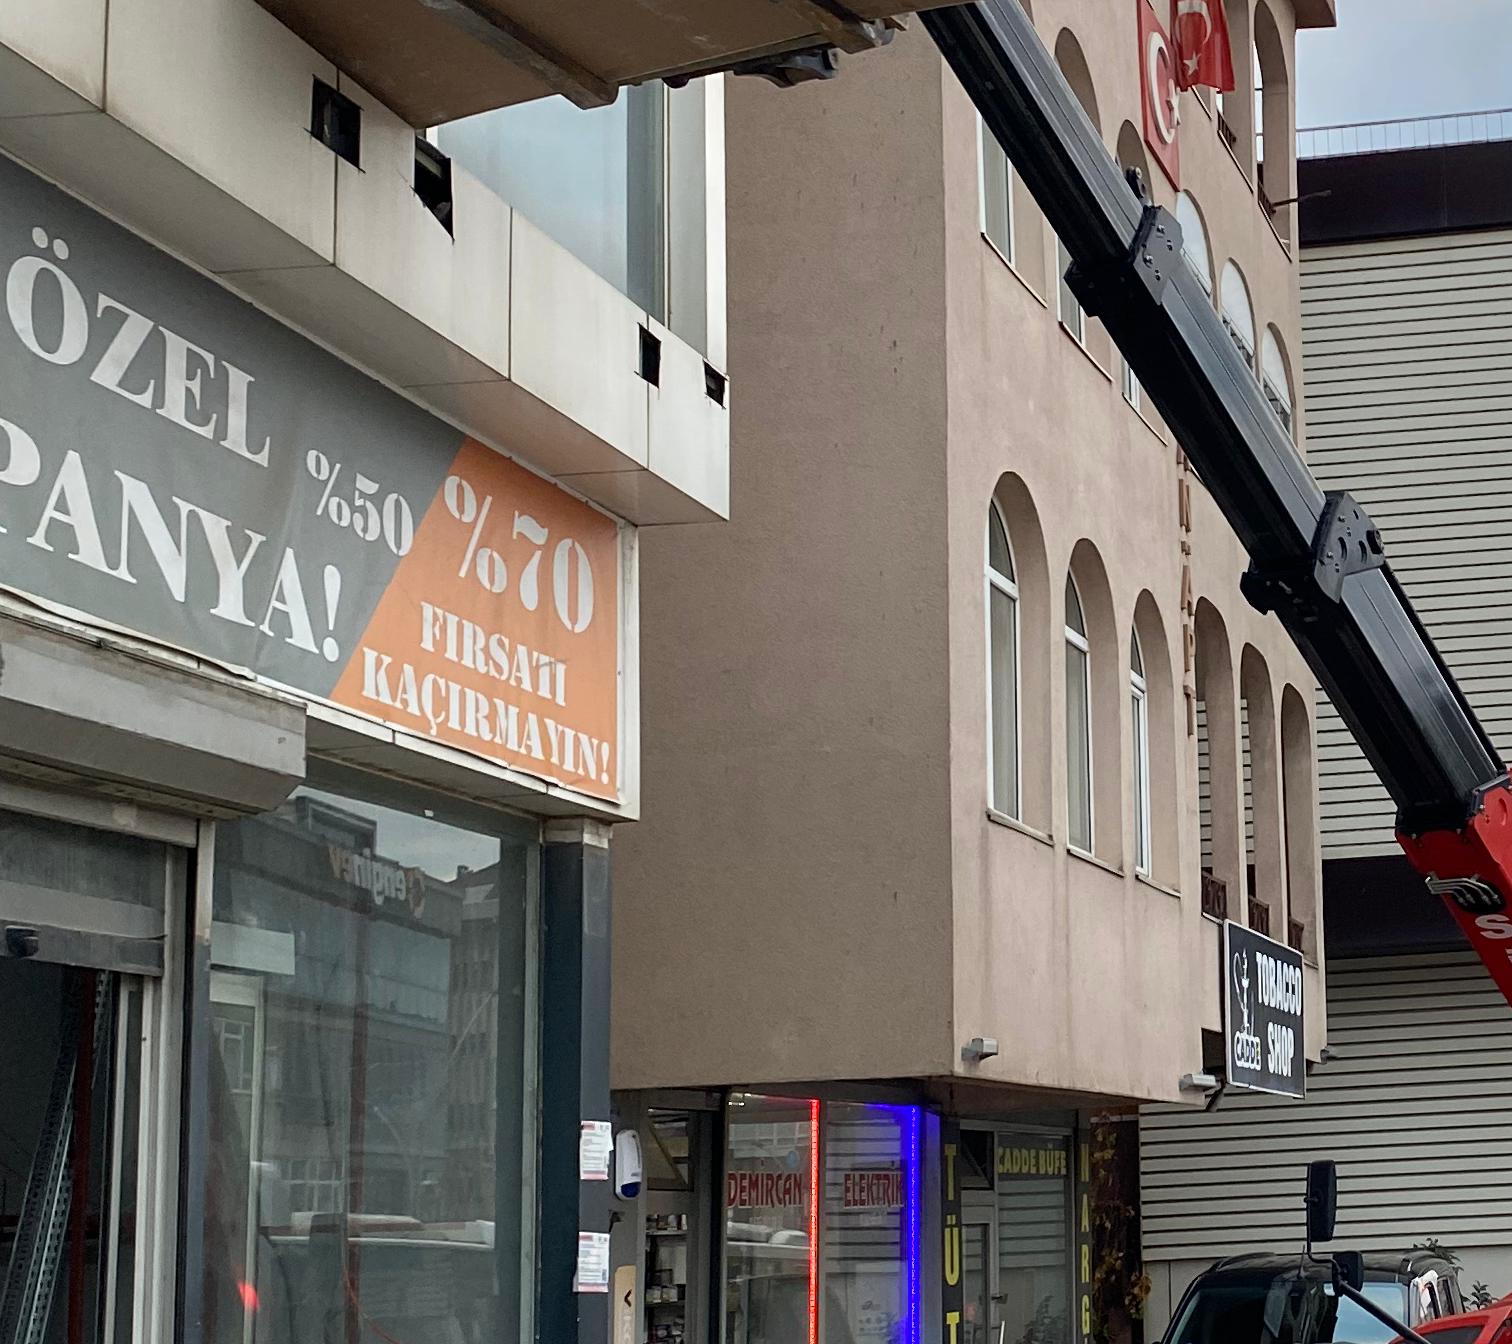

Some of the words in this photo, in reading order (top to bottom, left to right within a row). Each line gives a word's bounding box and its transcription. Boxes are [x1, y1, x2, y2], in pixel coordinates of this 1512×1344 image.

[6, 227, 271, 468] ÖZEL
[306, 448, 414, 558] %50
[444, 475, 595, 633] %70
[420, 600, 567, 706] FIRSATI
[362, 645, 610, 785] KAÇIRMAYIN!
[1255, 951, 1302, 1017] TOBACCO
[1267, 1021, 1294, 1078] SHOP
